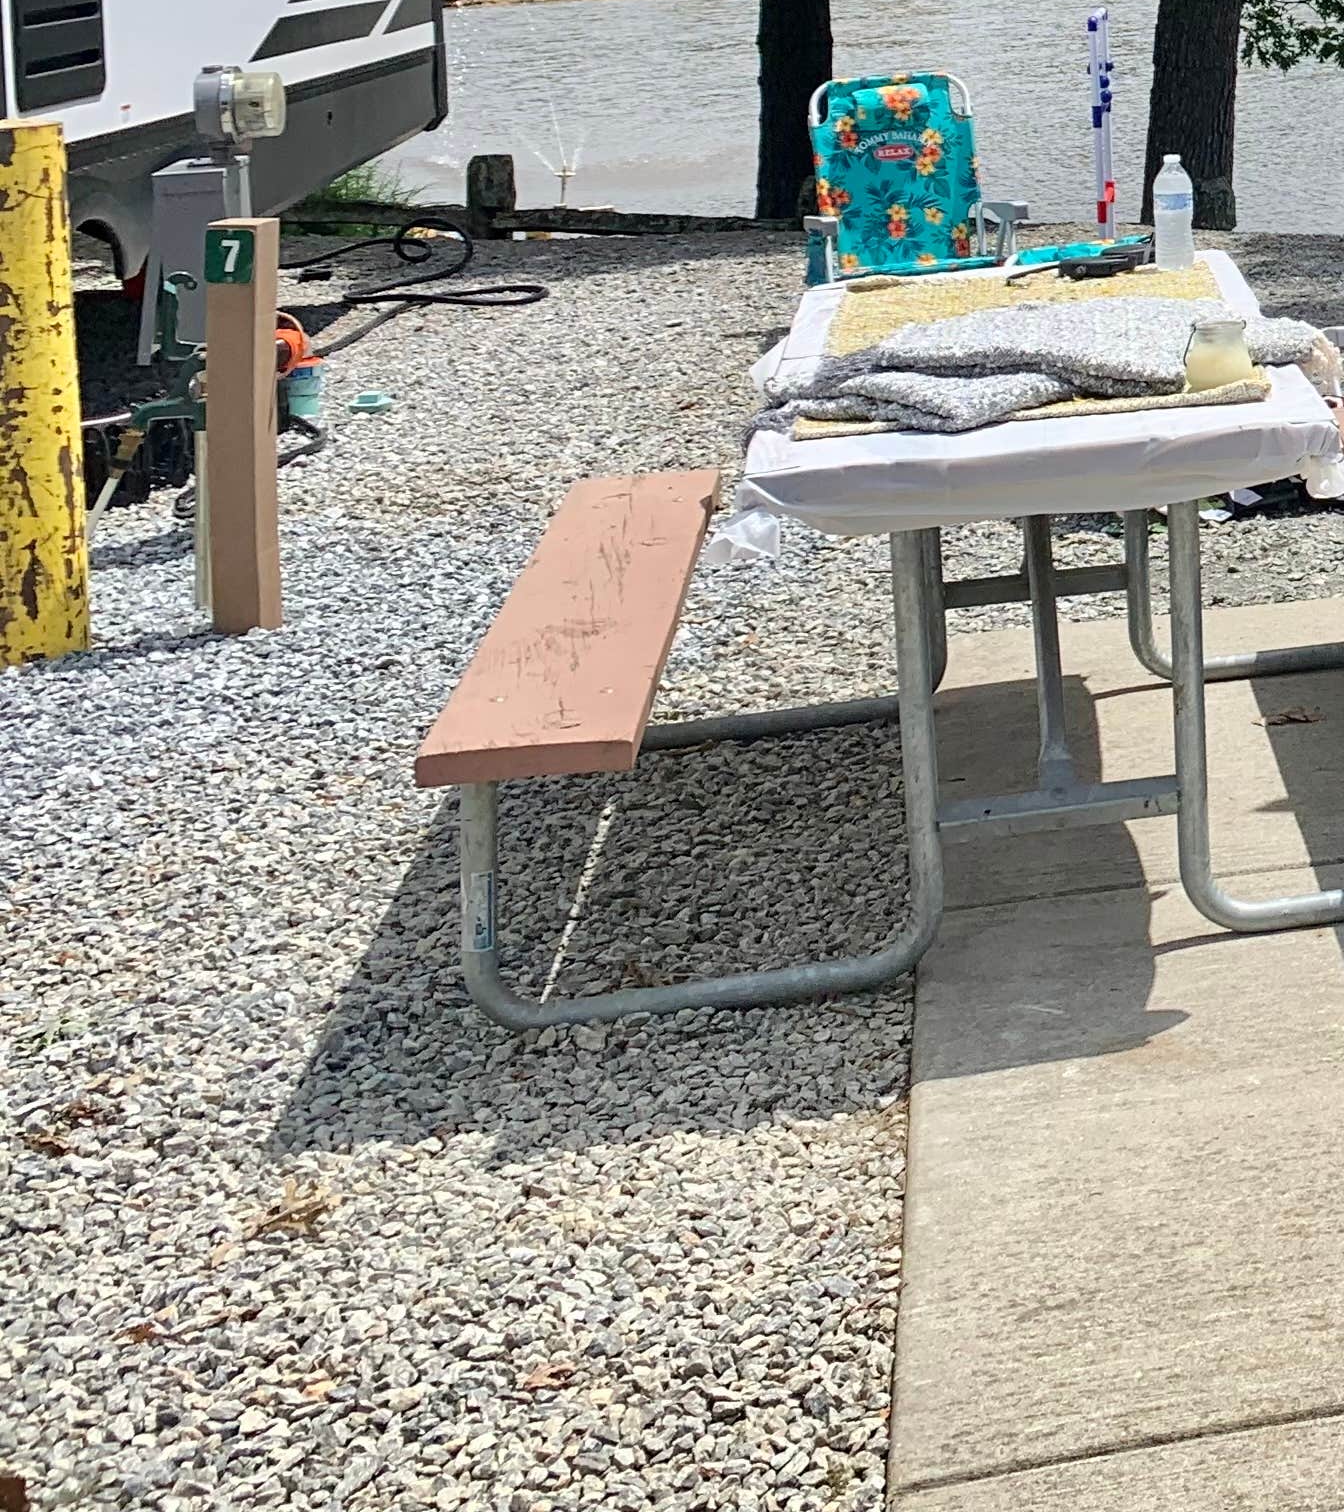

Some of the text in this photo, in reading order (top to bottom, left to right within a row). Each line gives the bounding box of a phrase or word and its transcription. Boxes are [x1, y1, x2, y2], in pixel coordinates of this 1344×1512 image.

[853, 131, 889, 155] TOMMY
[878, 148, 911, 157] RELAX
[221, 239, 240, 273] 7
